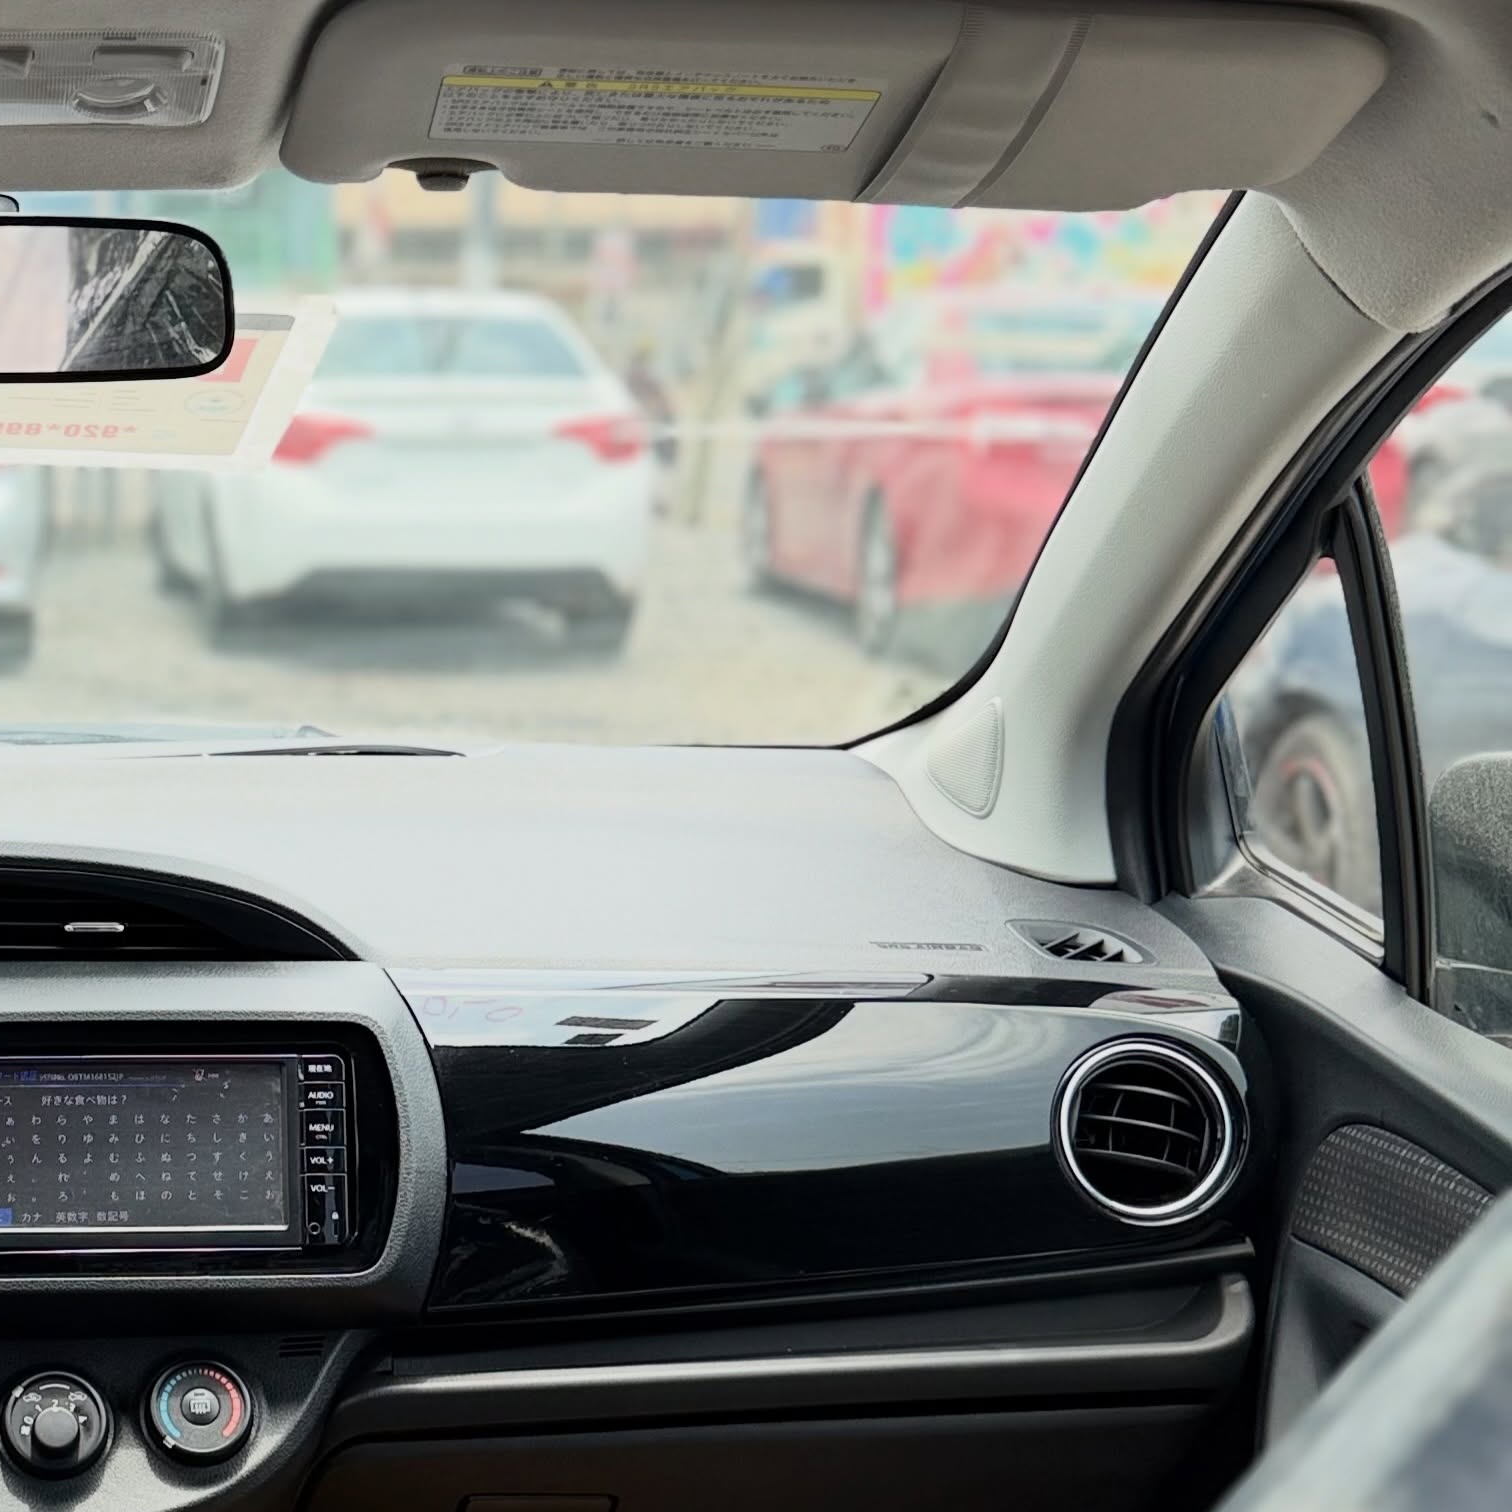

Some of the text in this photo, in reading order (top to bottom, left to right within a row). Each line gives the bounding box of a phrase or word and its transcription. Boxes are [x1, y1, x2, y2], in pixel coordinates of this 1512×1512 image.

[308, 1091, 335, 1100] AUDIO
[309, 1123, 335, 1132] MENU
[309, 1156, 335, 1165] VOL+
[21, 1212, 43, 1223] カナ
